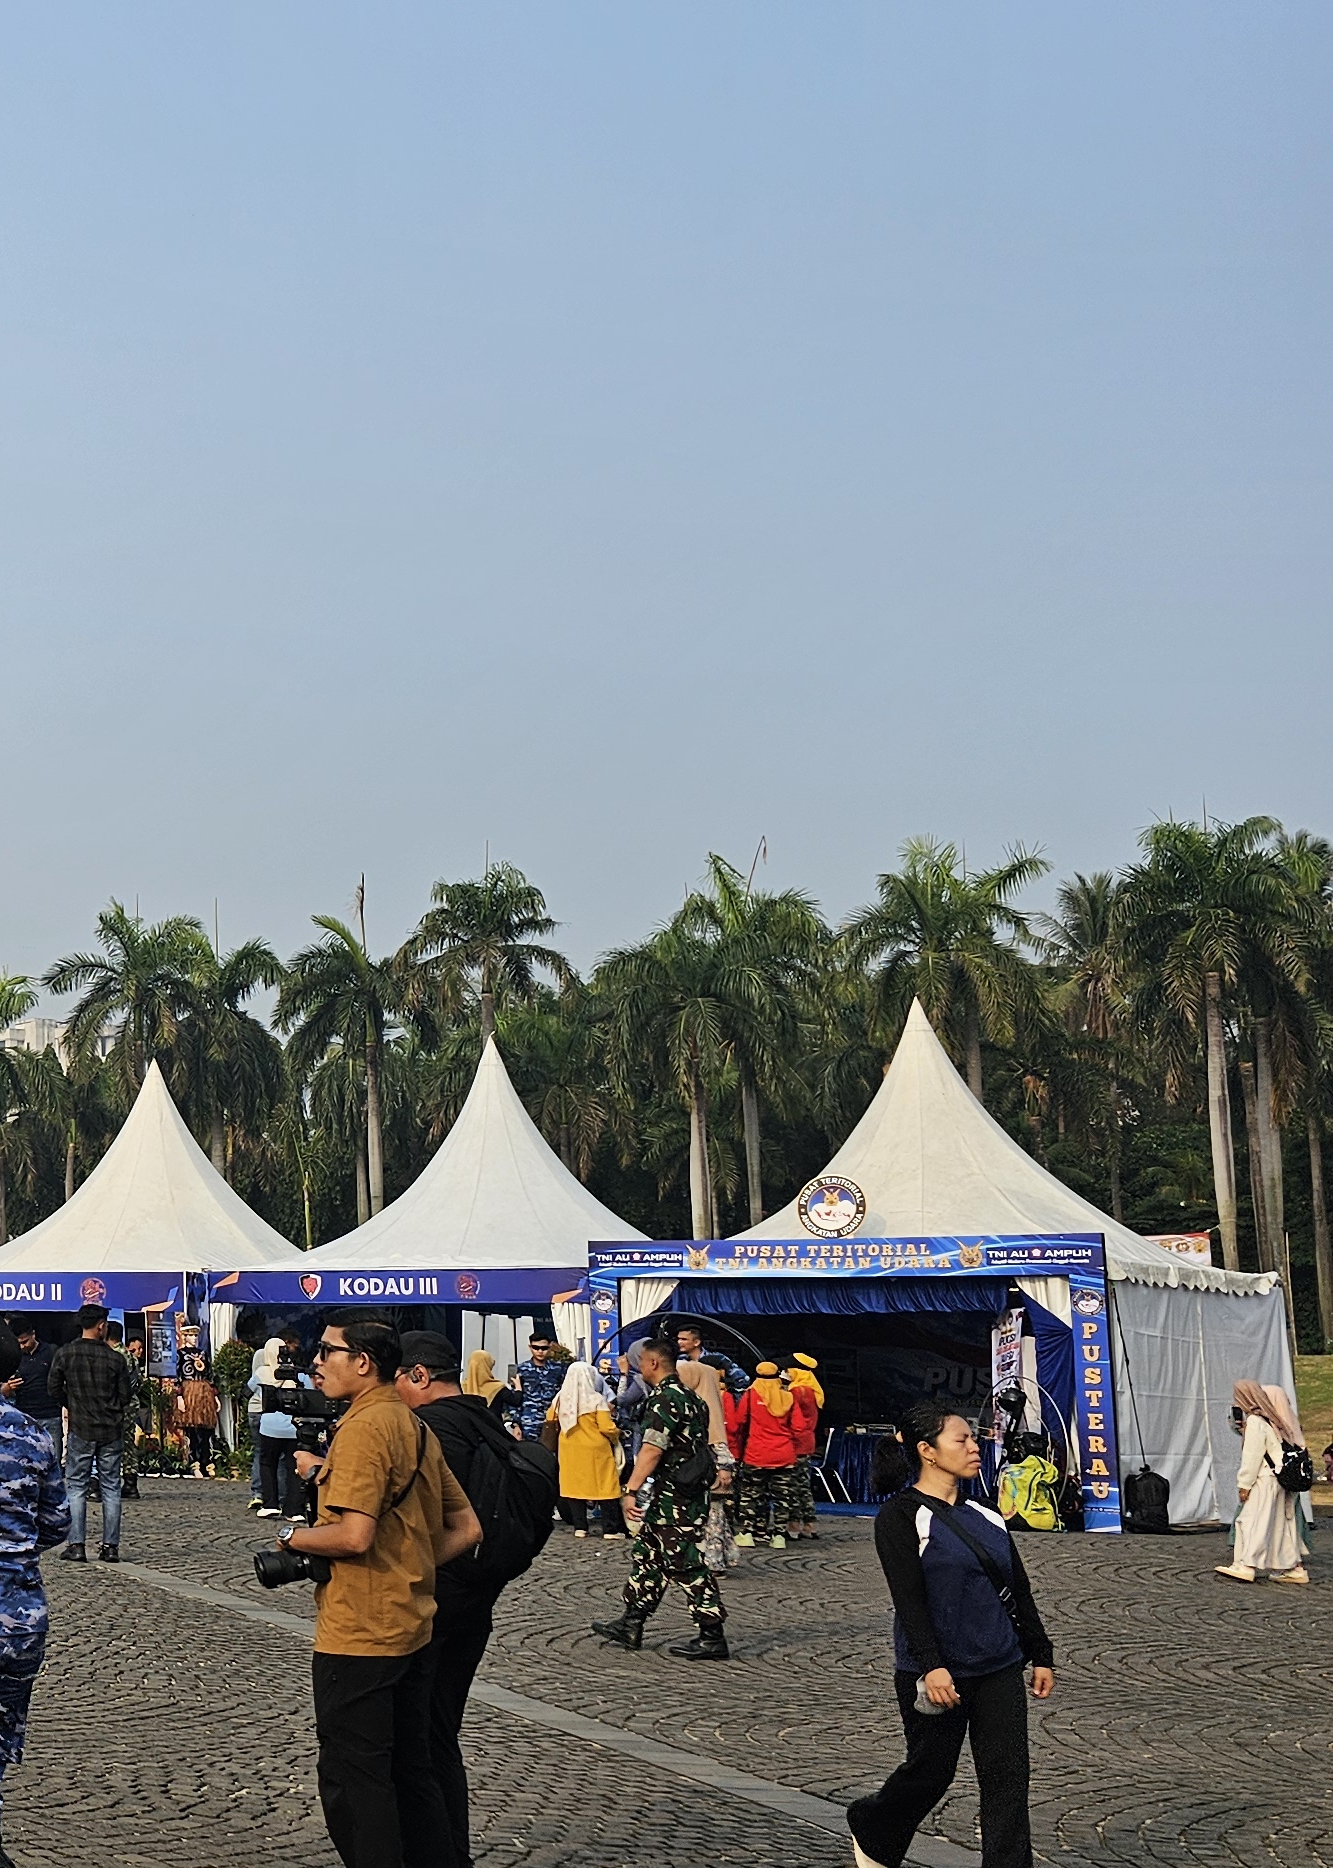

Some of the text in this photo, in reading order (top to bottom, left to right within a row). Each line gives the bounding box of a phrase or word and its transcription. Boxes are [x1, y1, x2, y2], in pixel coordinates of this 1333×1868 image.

[799, 1177, 864, 1205] PUSAT TERITORIAL
[801, 1214, 863, 1238] ANGKATAN UDARA
[596, 1254, 613, 1262] TNI
[735, 1244, 930, 1258] PUSAT TERITORIAL
[987, 1249, 1091, 1258] TNI AU AMPUH
[715, 1256, 951, 1270] TNI ANGKATAN UDARA
[51, 1283, 62, 1300] II
[339, 1278, 437, 1296] KODAU III
[1081, 1322, 1110, 1500] PUSTERAU
